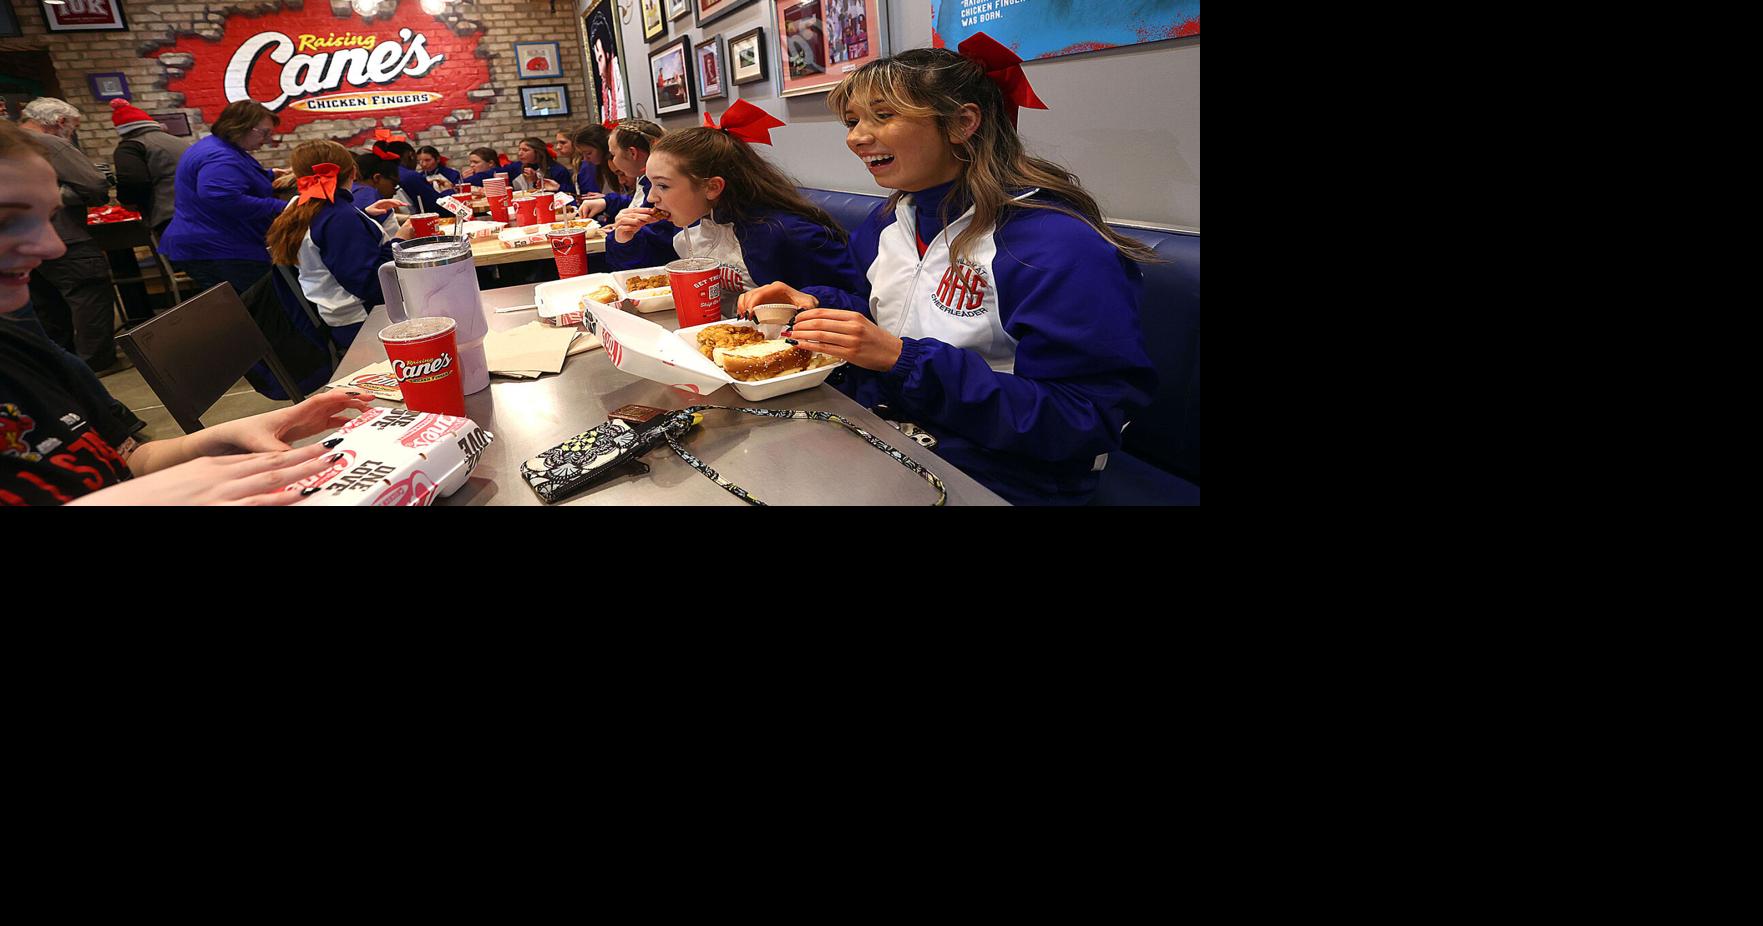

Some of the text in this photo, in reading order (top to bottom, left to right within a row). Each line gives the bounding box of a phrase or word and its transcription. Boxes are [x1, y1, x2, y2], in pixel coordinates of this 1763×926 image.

[961, 3, 993, 17] CHICKEN
[961, 10, 1003, 27] WAS BORN.
[298, 32, 376, 51] Raising
[224, 28, 444, 111] Cane's
[307, 93, 429, 109] CHICKEN FINGERS
[930, 293, 989, 318] CHEERLEADER
[392, 352, 453, 382] Cane's
[326, 460, 384, 492] LOVE
[348, 465, 397, 492] ONE
